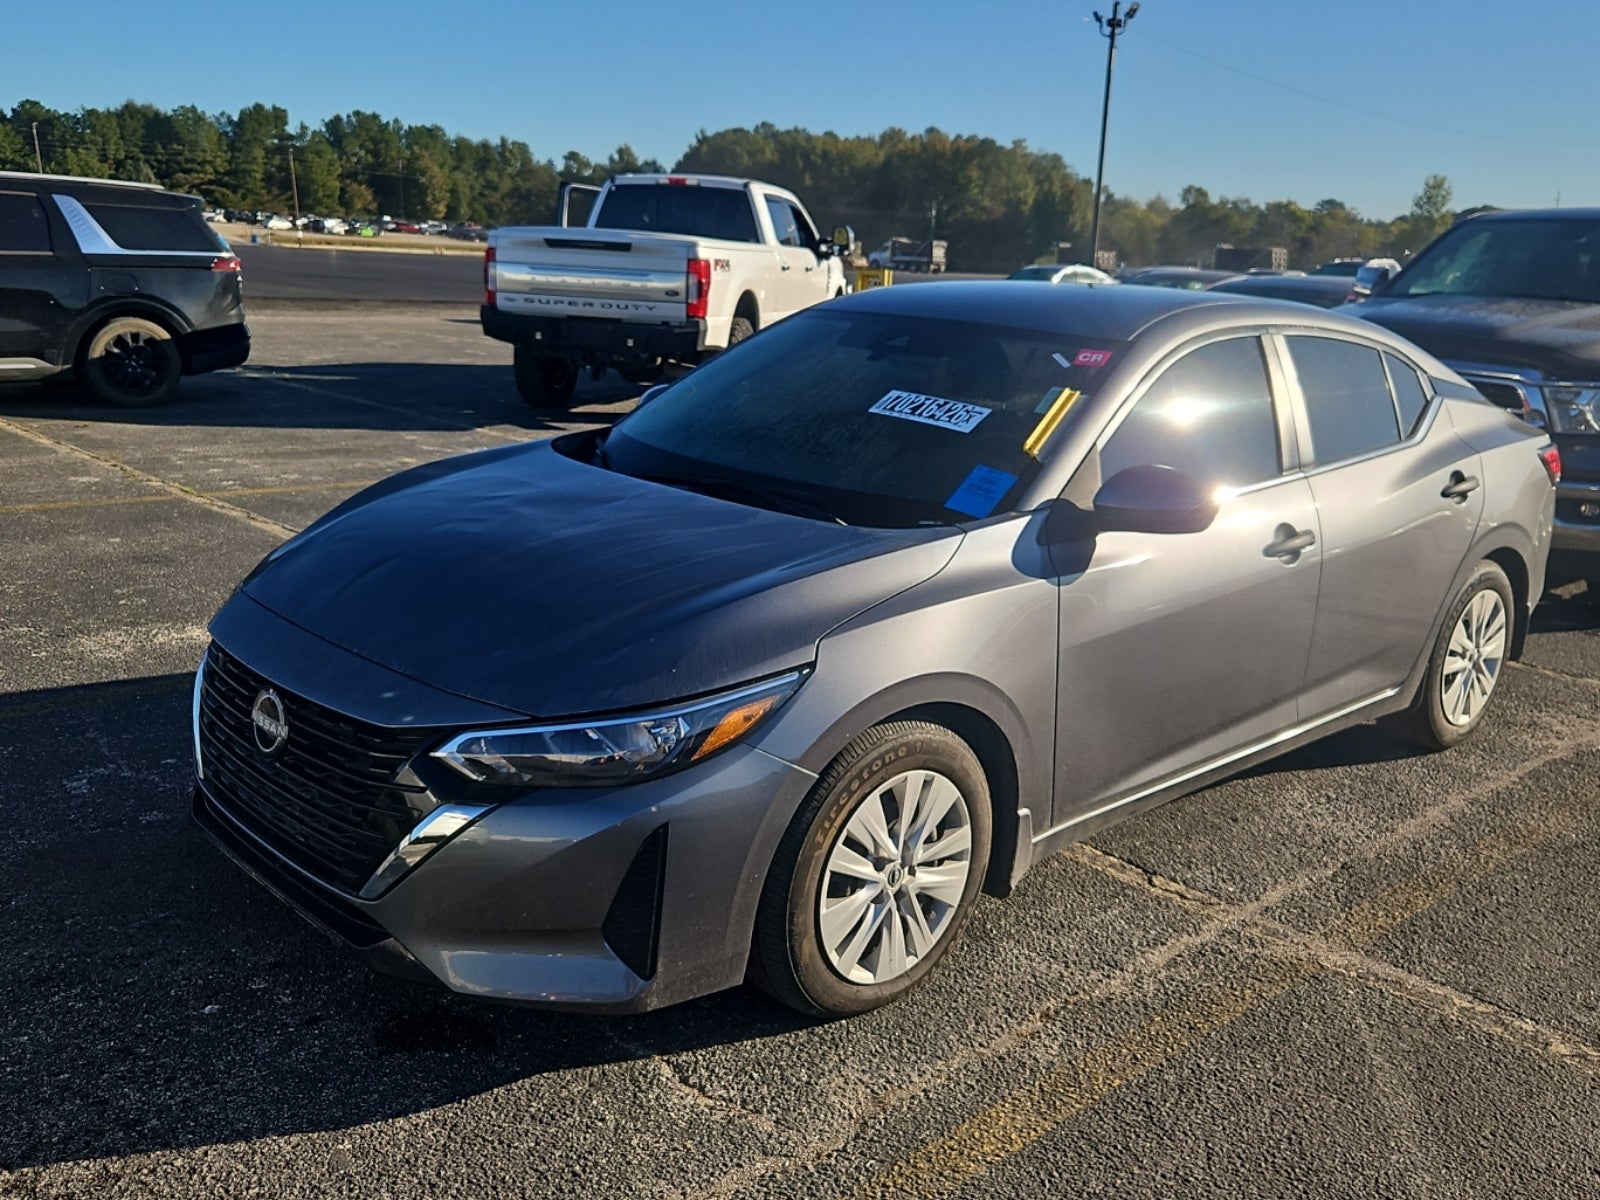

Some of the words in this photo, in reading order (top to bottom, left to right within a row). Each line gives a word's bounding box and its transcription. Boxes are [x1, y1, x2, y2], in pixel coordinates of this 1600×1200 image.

[523, 297, 594, 308] SUPER
[600, 303, 658, 312] DUTY
[1078, 353, 1104, 362] CR
[886, 395, 973, 424] 70216426
